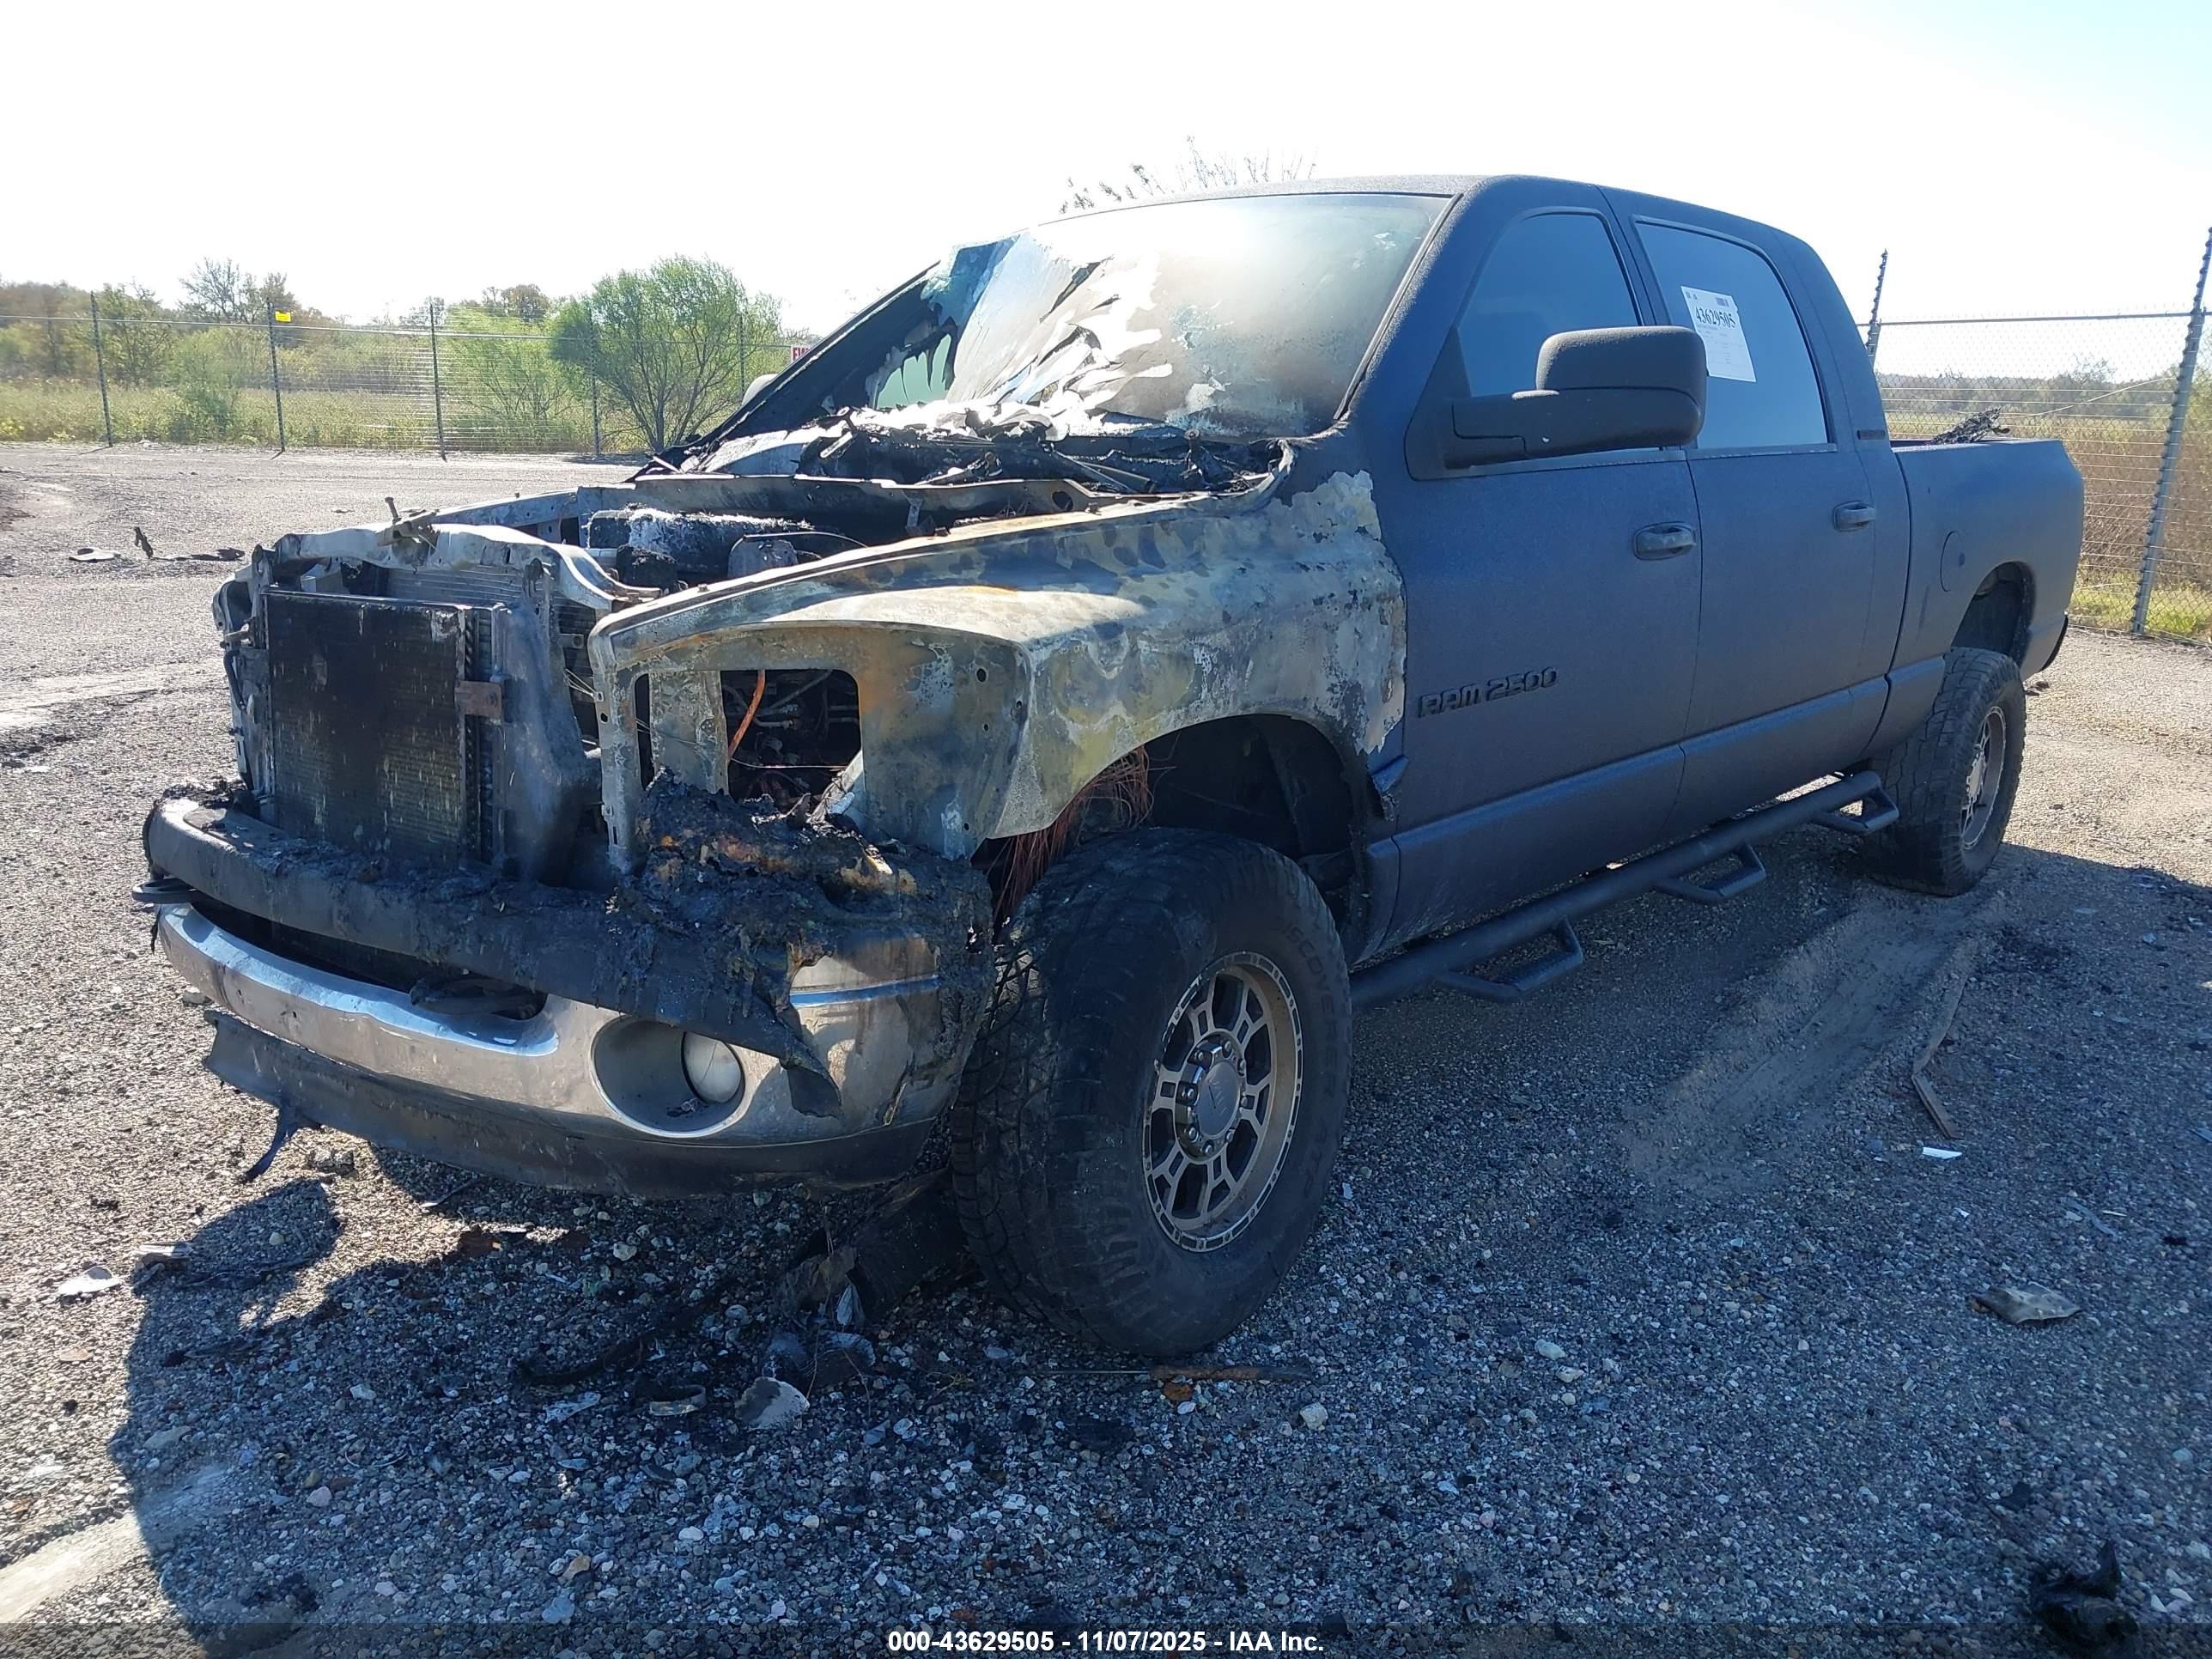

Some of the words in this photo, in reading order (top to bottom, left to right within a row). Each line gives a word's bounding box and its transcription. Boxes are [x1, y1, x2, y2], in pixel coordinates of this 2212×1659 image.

[1695, 307, 1736, 328] 43629505
[1419, 684, 1481, 718] RAM
[1487, 666, 1558, 701] 2500
